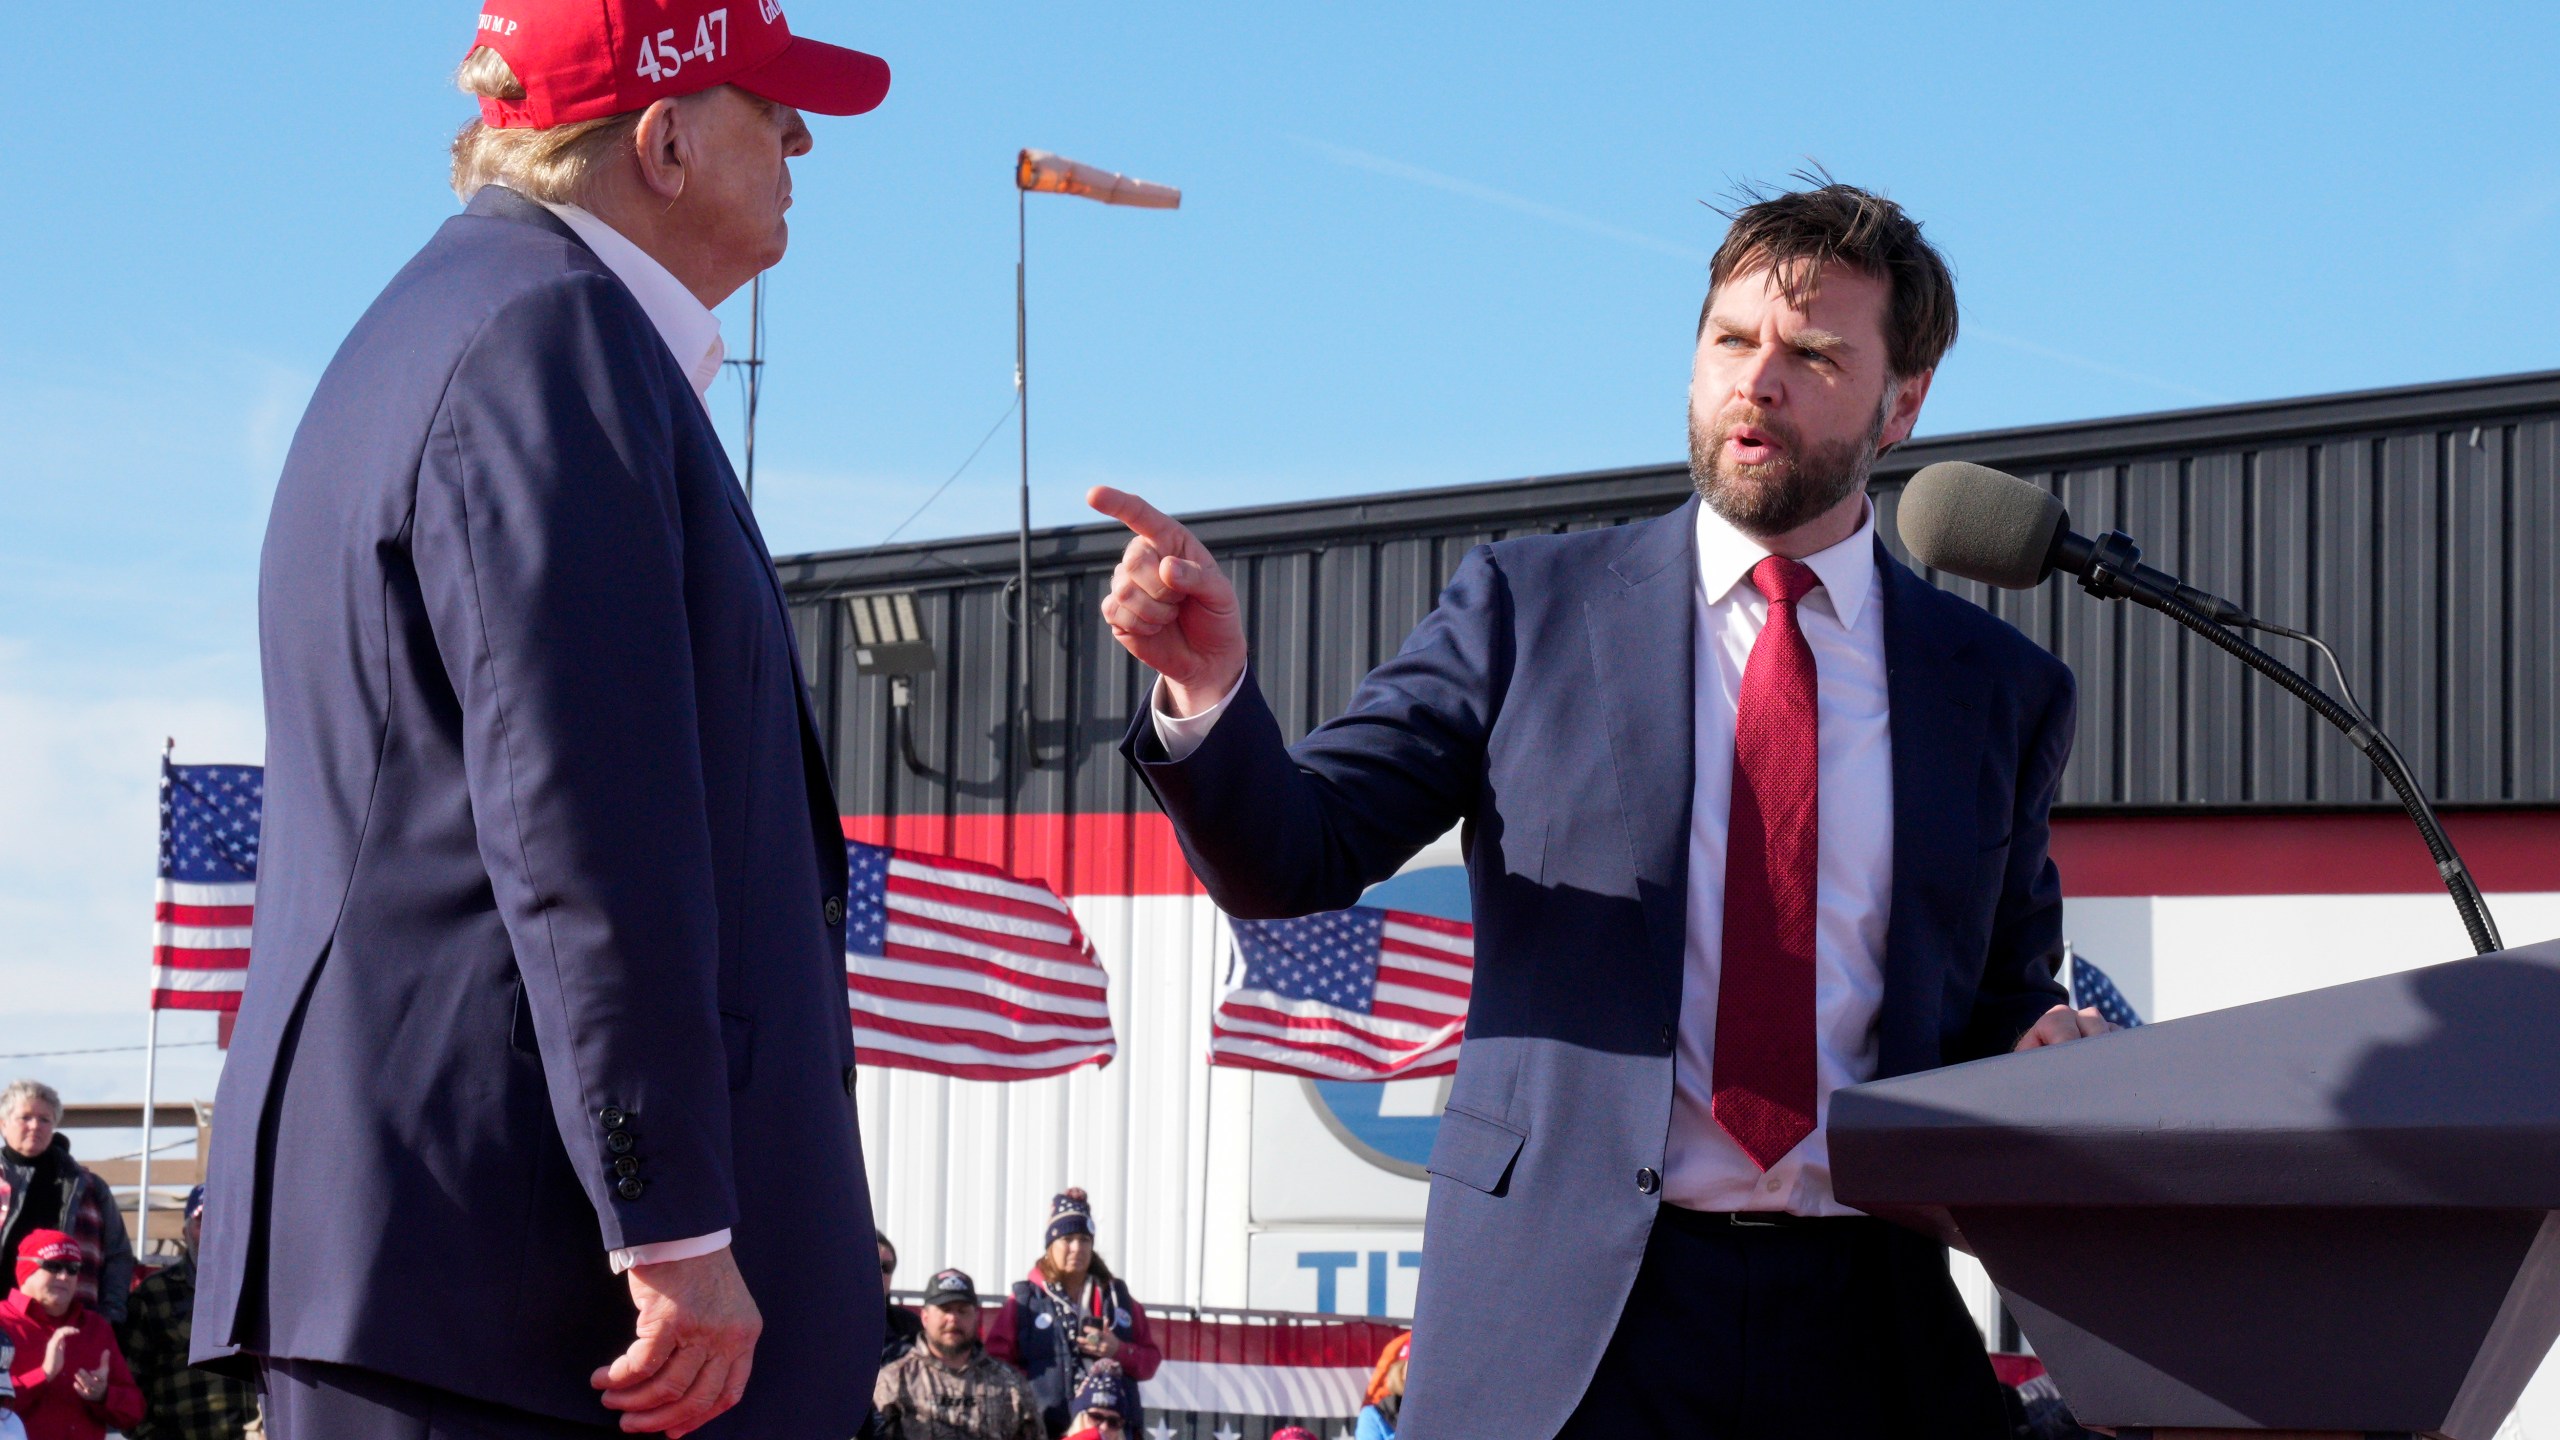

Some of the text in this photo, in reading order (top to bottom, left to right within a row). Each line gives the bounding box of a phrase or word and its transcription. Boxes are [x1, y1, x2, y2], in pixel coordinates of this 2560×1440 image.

[478, 13, 518, 36] RUMP
[636, 7, 728, 83] 45-47
[1297, 1251, 1422, 1317] TI
